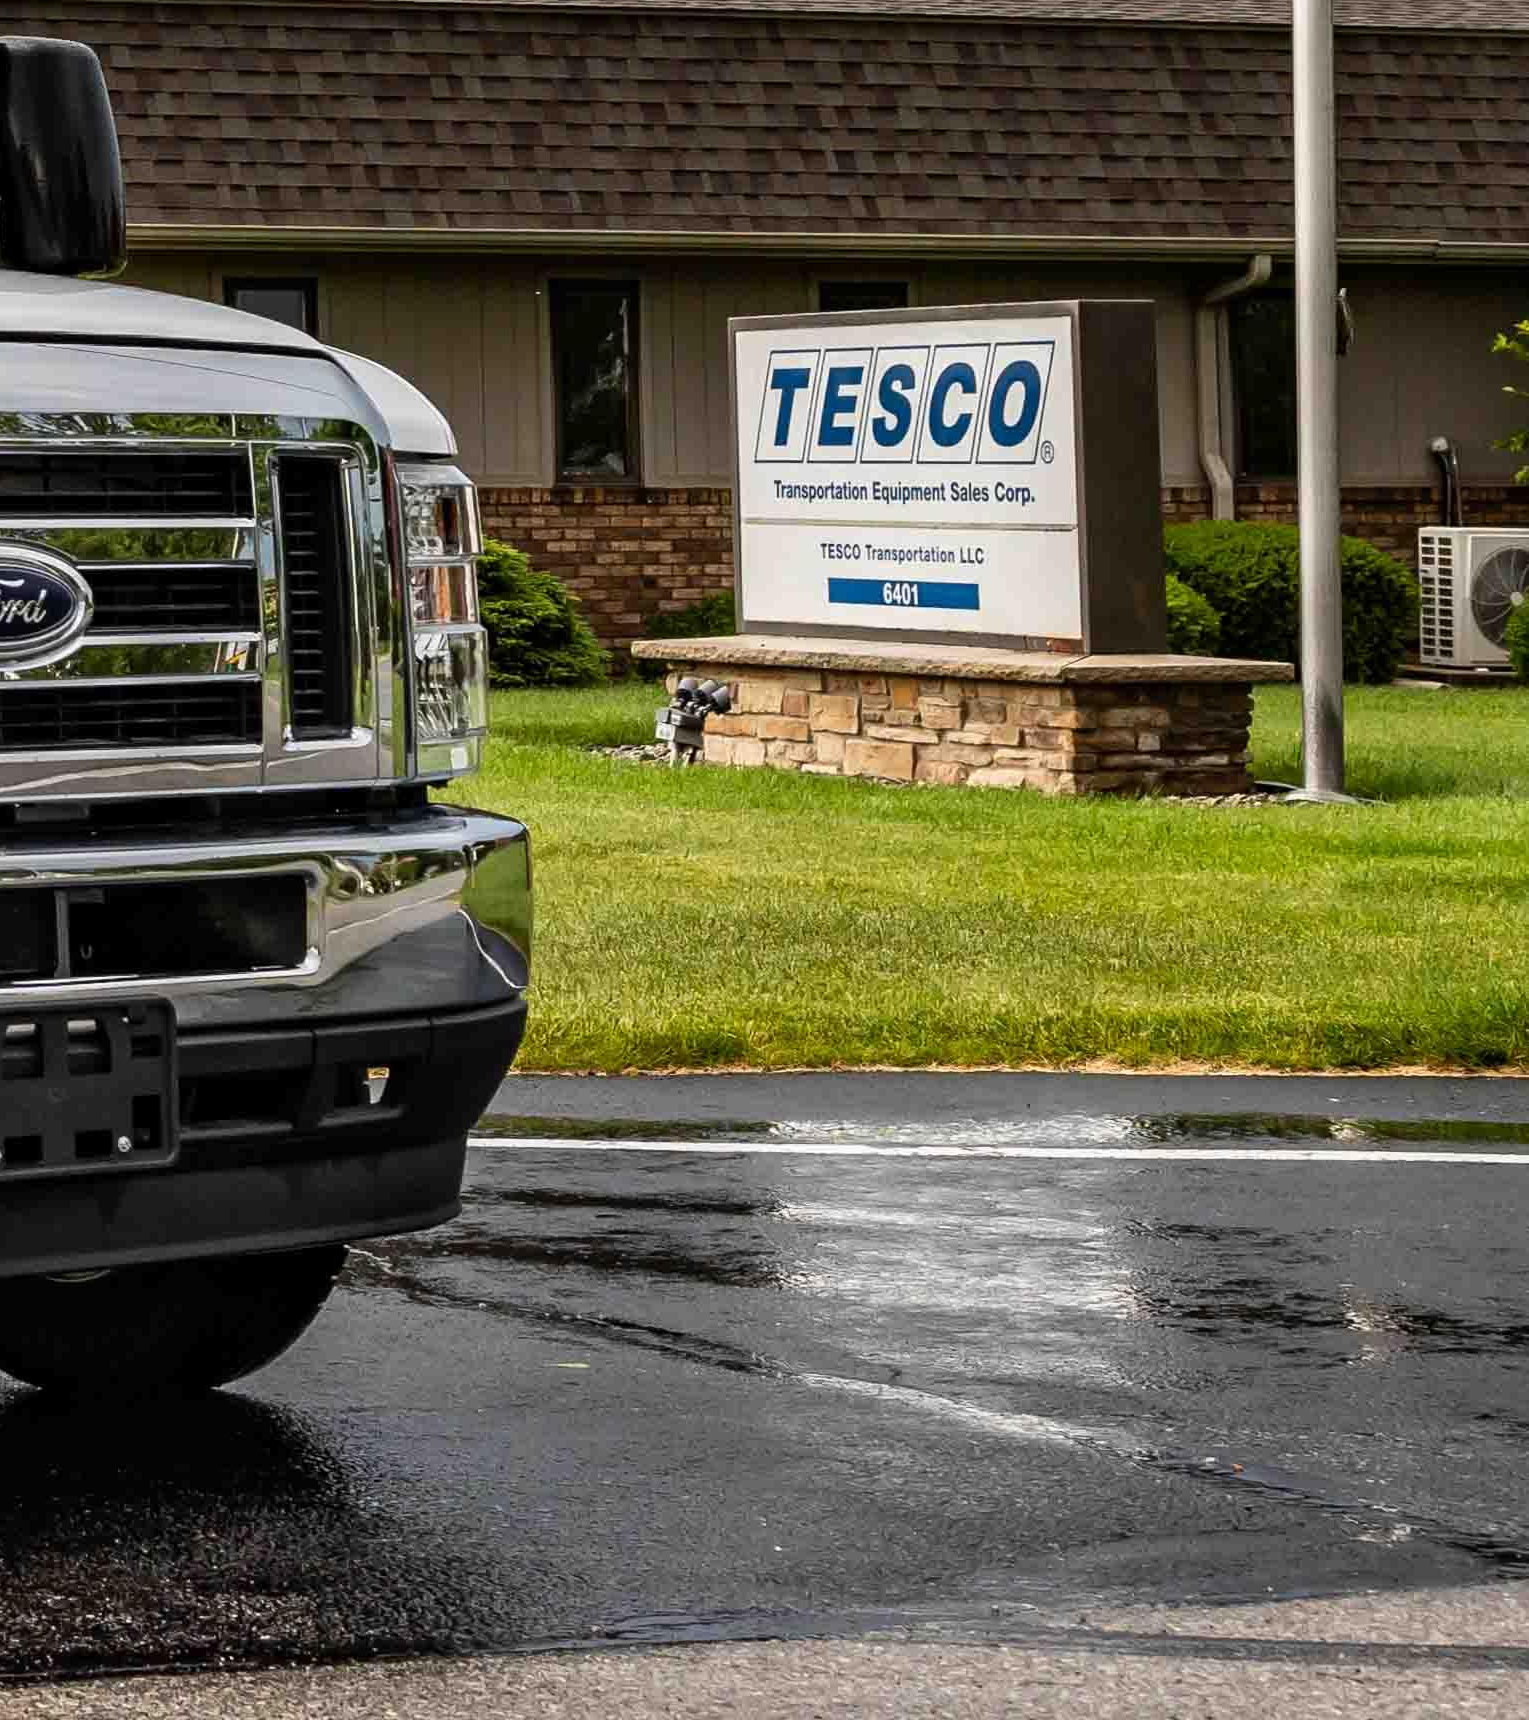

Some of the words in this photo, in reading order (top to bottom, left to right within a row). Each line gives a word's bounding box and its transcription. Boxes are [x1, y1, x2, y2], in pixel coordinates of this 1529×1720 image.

[770, 360, 1042, 448] TESCO
[773, 480, 868, 502] Transportation
[872, 481, 946, 504] Equipment
[950, 482, 989, 502] Sales
[994, 482, 1037, 506] Corp.
[820, 543, 861, 560] TESCO
[865, 545, 955, 564] Transportation
[959, 548, 985, 564] LLC
[882, 583, 919, 605] 6401
